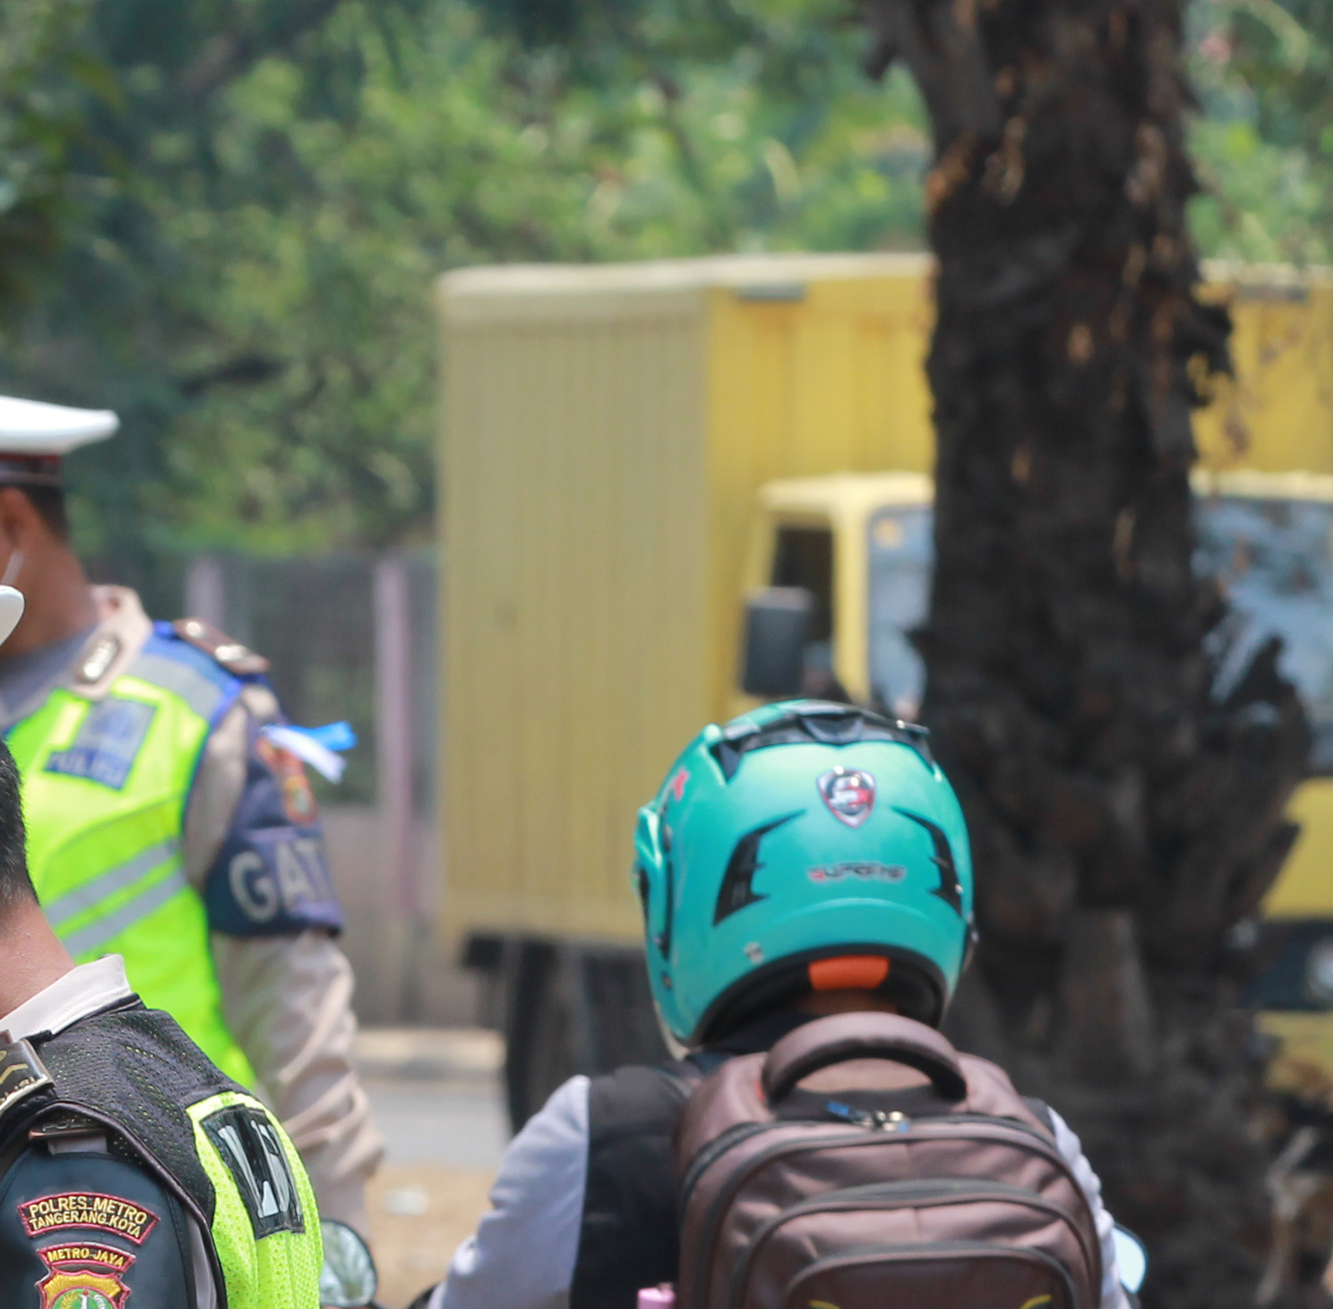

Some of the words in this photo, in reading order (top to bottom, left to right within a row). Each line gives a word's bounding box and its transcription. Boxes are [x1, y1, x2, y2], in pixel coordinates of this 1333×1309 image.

[29, 1196, 87, 1218] POLRES
[93, 1197, 147, 1225] METRO
[29, 1210, 106, 1231] TANGERANG
[107, 1215, 142, 1238] KOTA
[46, 1247, 90, 1263] METRO
[93, 1249, 125, 1268] JAYA
